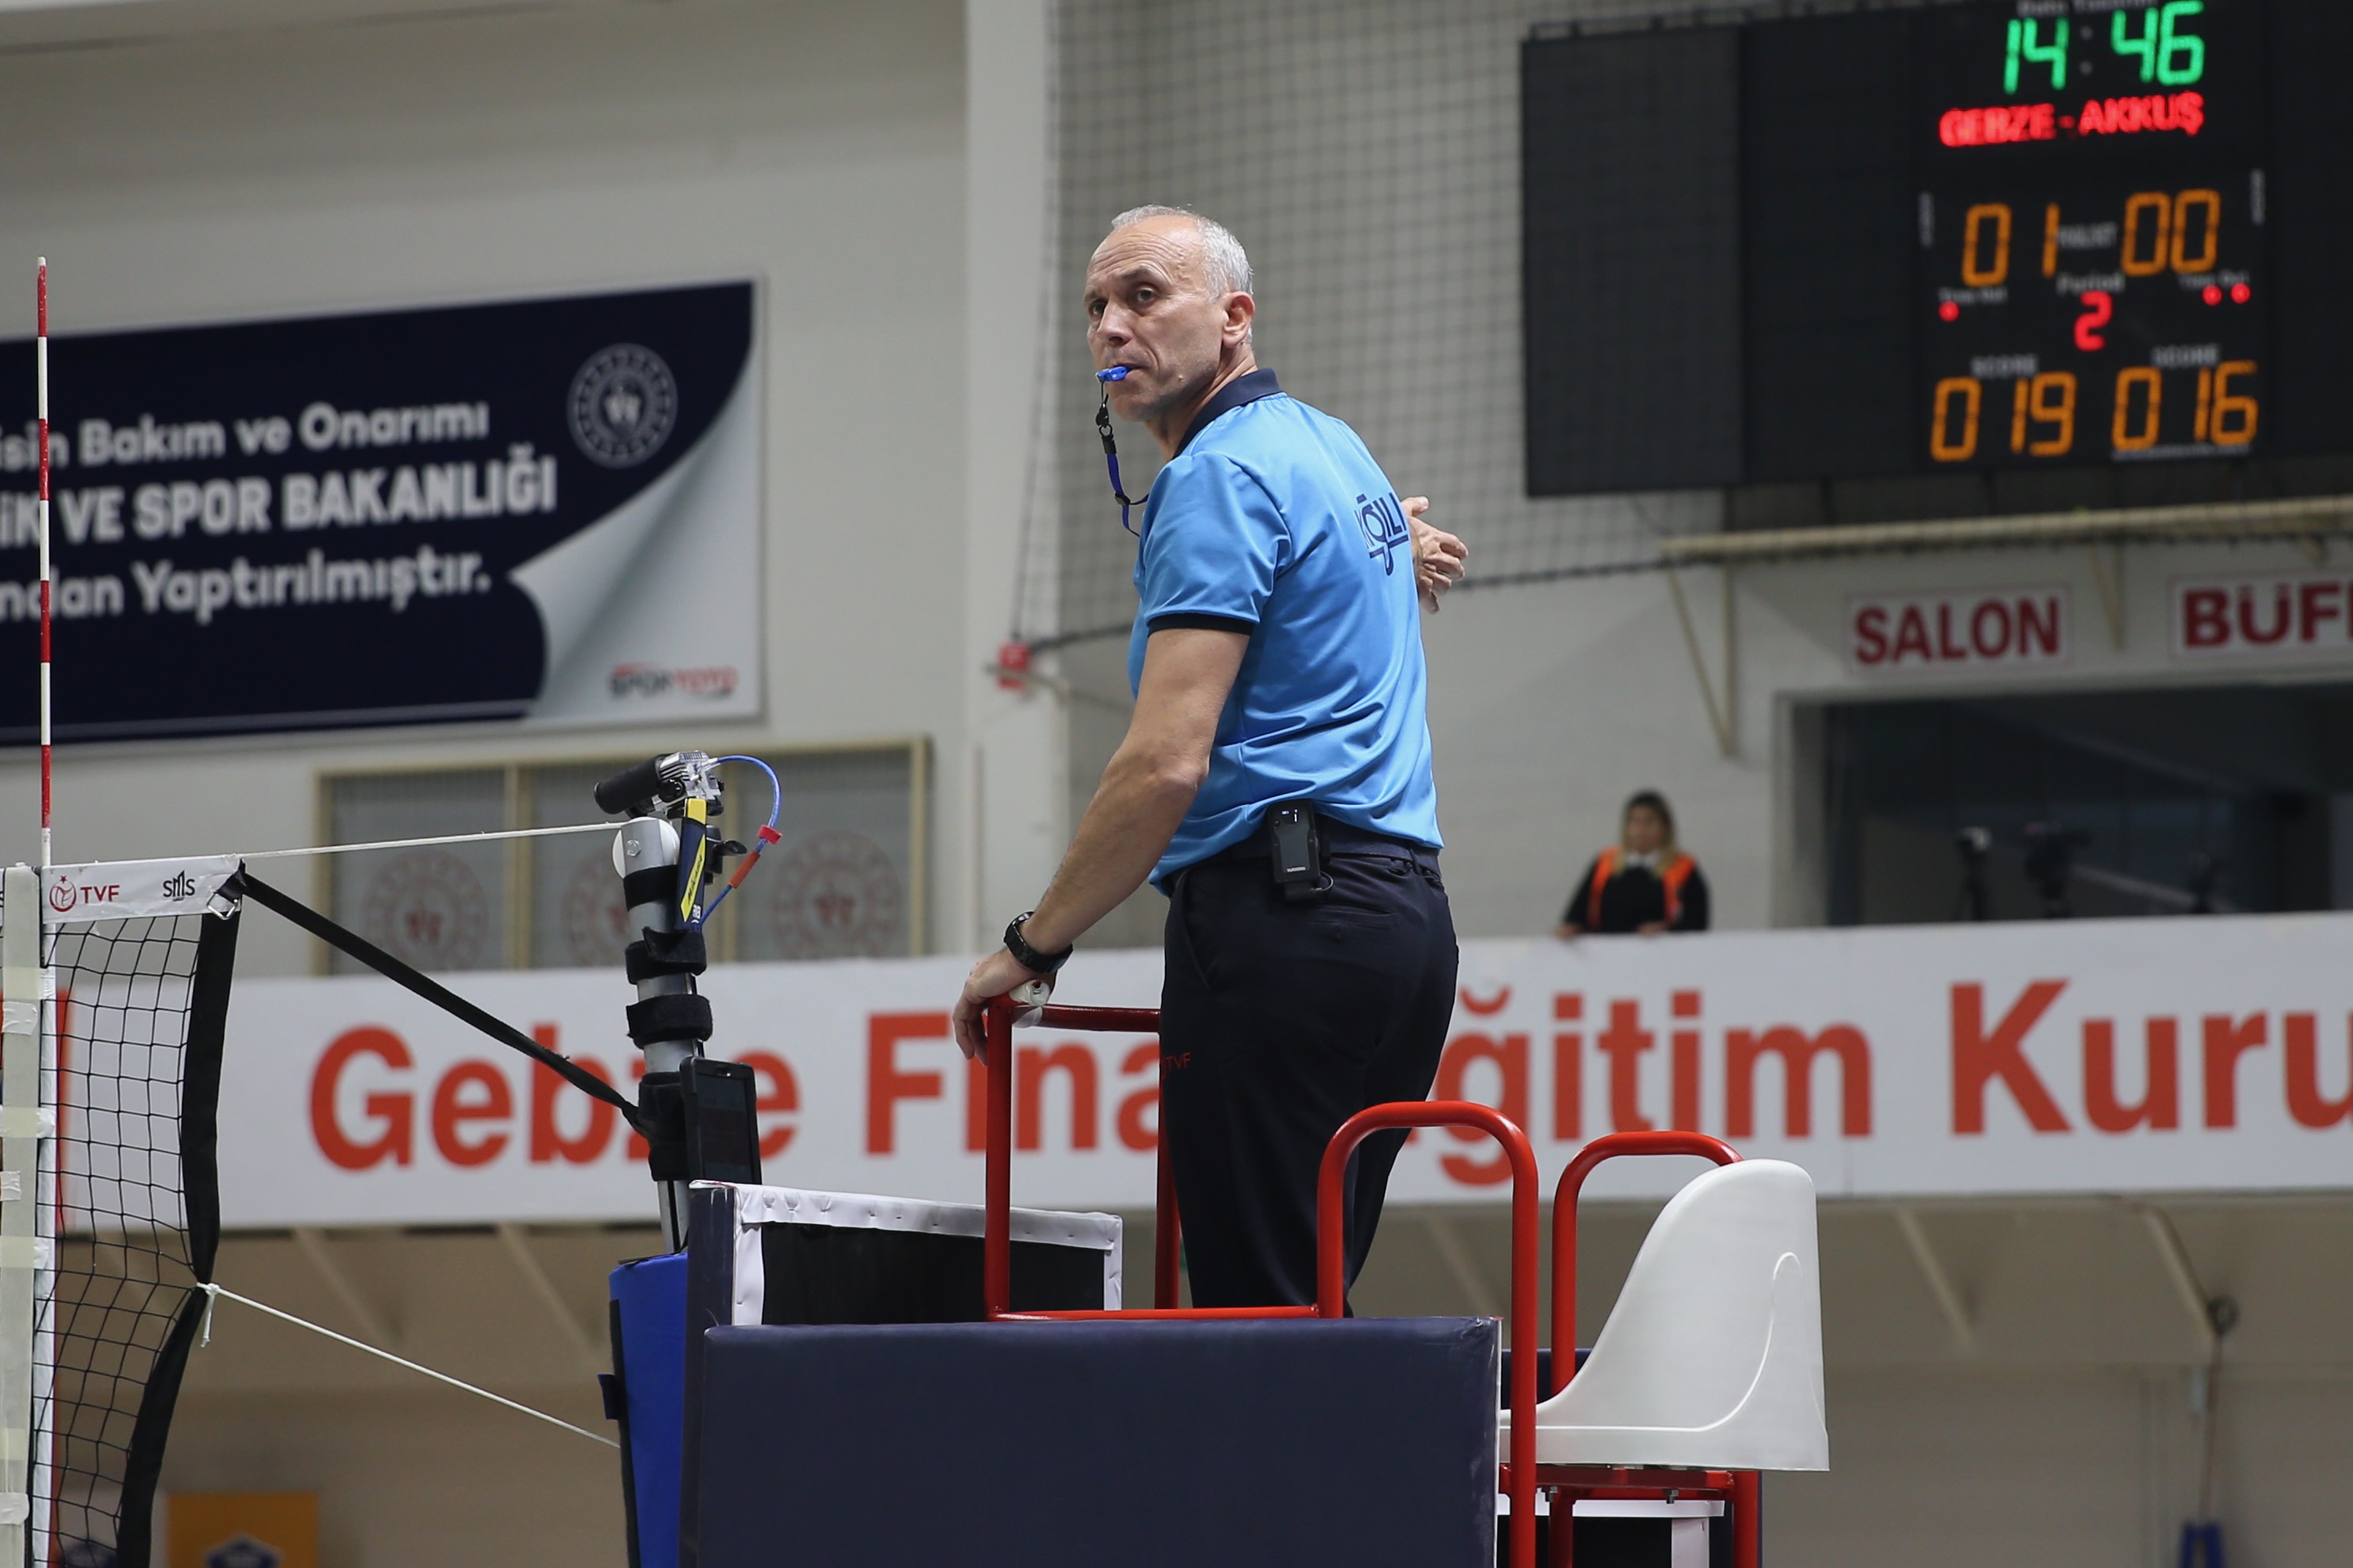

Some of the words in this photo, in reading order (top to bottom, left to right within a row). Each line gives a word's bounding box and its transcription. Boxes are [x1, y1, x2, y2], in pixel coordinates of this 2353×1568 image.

[2078, 91, 2204, 135] AKKUŞ
[2121, 189, 2219, 276] 00
[2074, 290, 2112, 351] 2
[79, 414, 226, 466] Bakım
[235, 417, 292, 455] ve
[299, 402, 490, 452] Onarımı
[1930, 372, 2077, 461] 019
[2111, 360, 2259, 450] 016
[58, 486, 124, 544] VE
[133, 476, 272, 540] SPOR
[281, 442, 557, 530] BAKANLIĞI
[132, 544, 492, 624] Yaptırılmıştır.
[2183, 580, 2353, 649] BÜF
[1855, 597, 2061, 665] SALON
[81, 884, 120, 904] TVF
